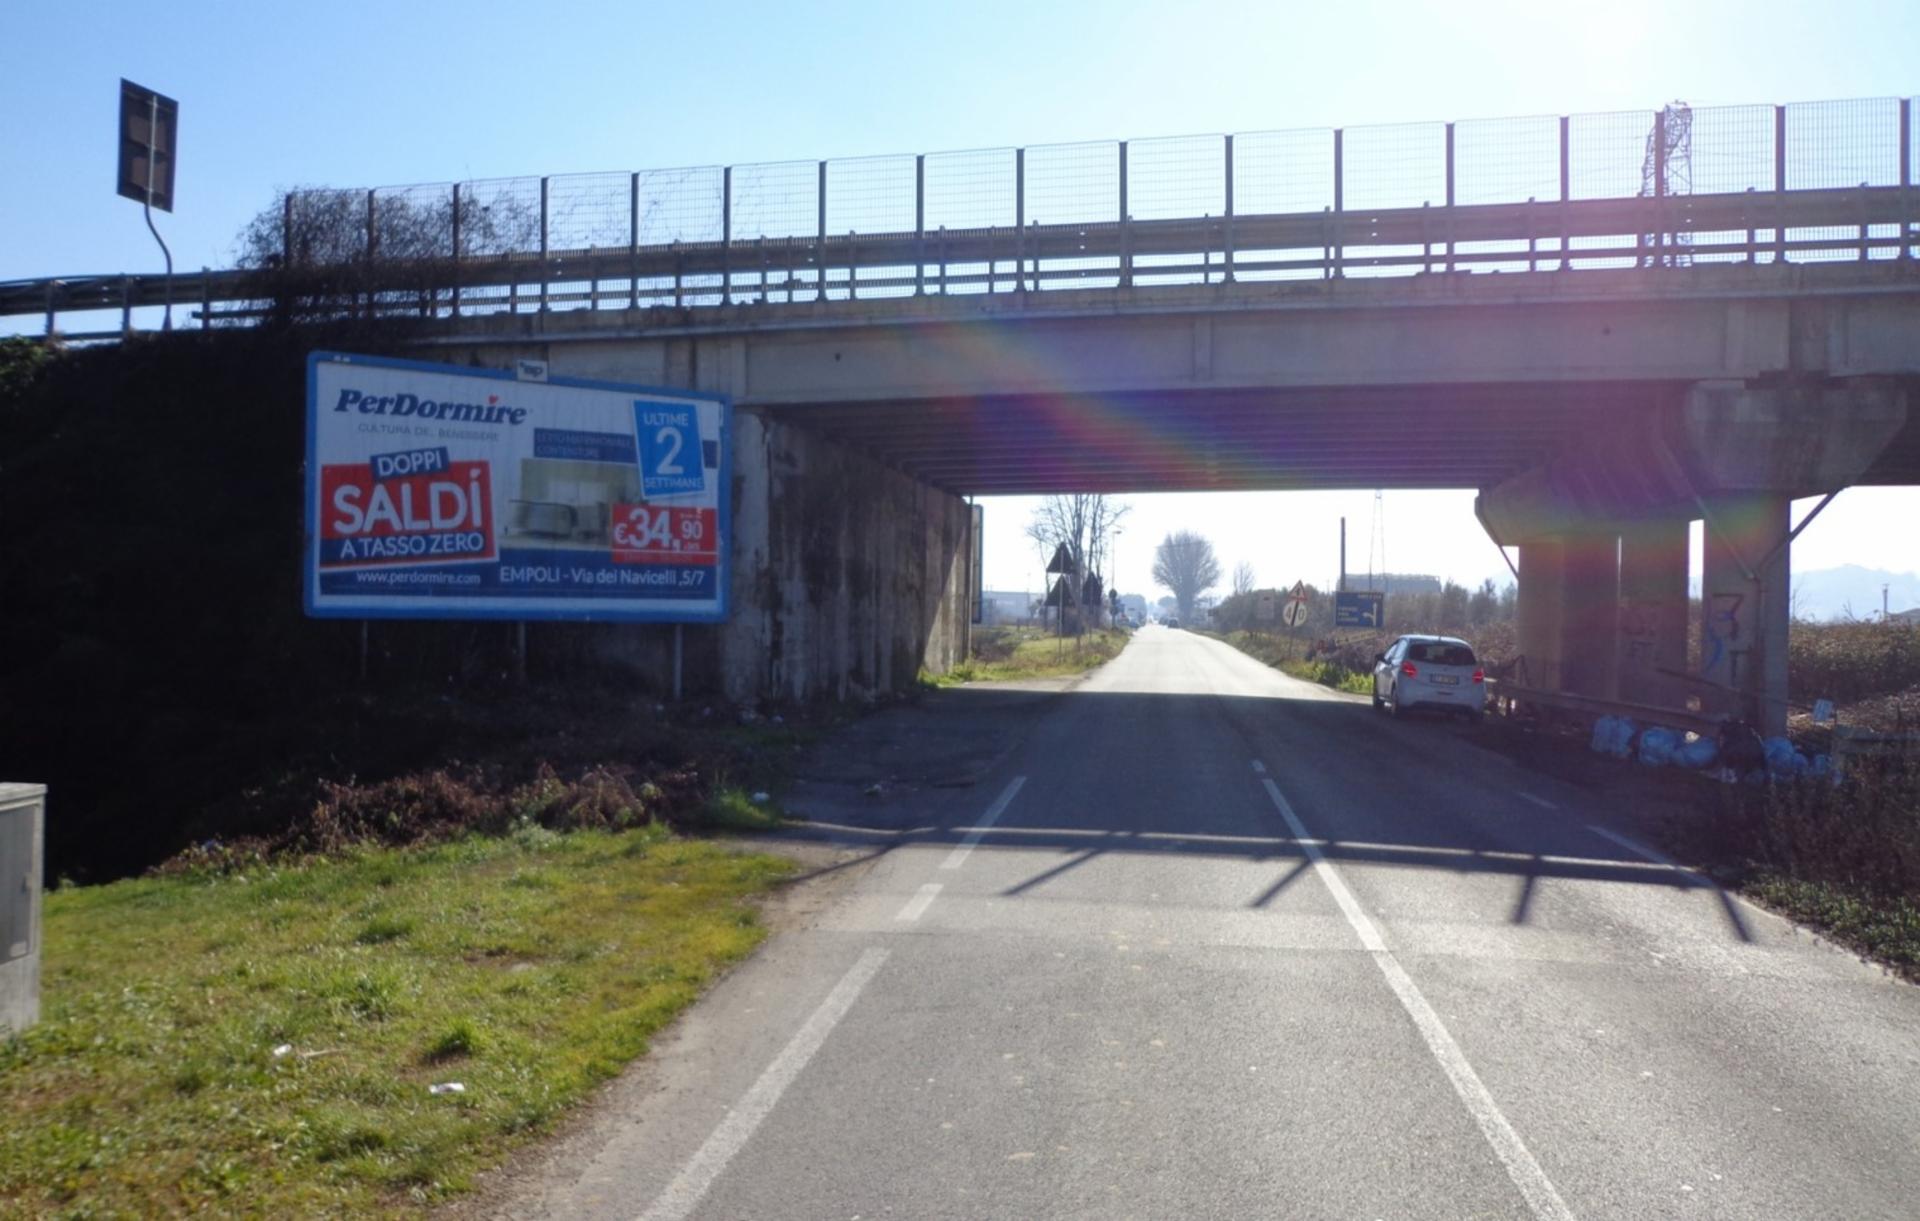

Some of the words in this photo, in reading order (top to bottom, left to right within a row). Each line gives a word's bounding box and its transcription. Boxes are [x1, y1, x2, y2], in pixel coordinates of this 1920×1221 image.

[334, 388, 527, 424] PerDormire
[358, 423, 410, 434] CULTURA
[643, 412, 689, 427] ULTIME
[656, 426, 685, 475] 2
[378, 450, 442, 476] DOPPI
[645, 476, 704, 489] SETTIMANE
[340, 539, 357, 560] A
[358, 534, 426, 558] TASSO
[429, 531, 484, 553] ZERO
[356, 570, 481, 585] www.perdormire.com
[499, 566, 561, 582] EMPOLI
[571, 567, 594, 584] Via
[596, 569, 618, 584] dei
[620, 569, 676, 585] Navicelli
